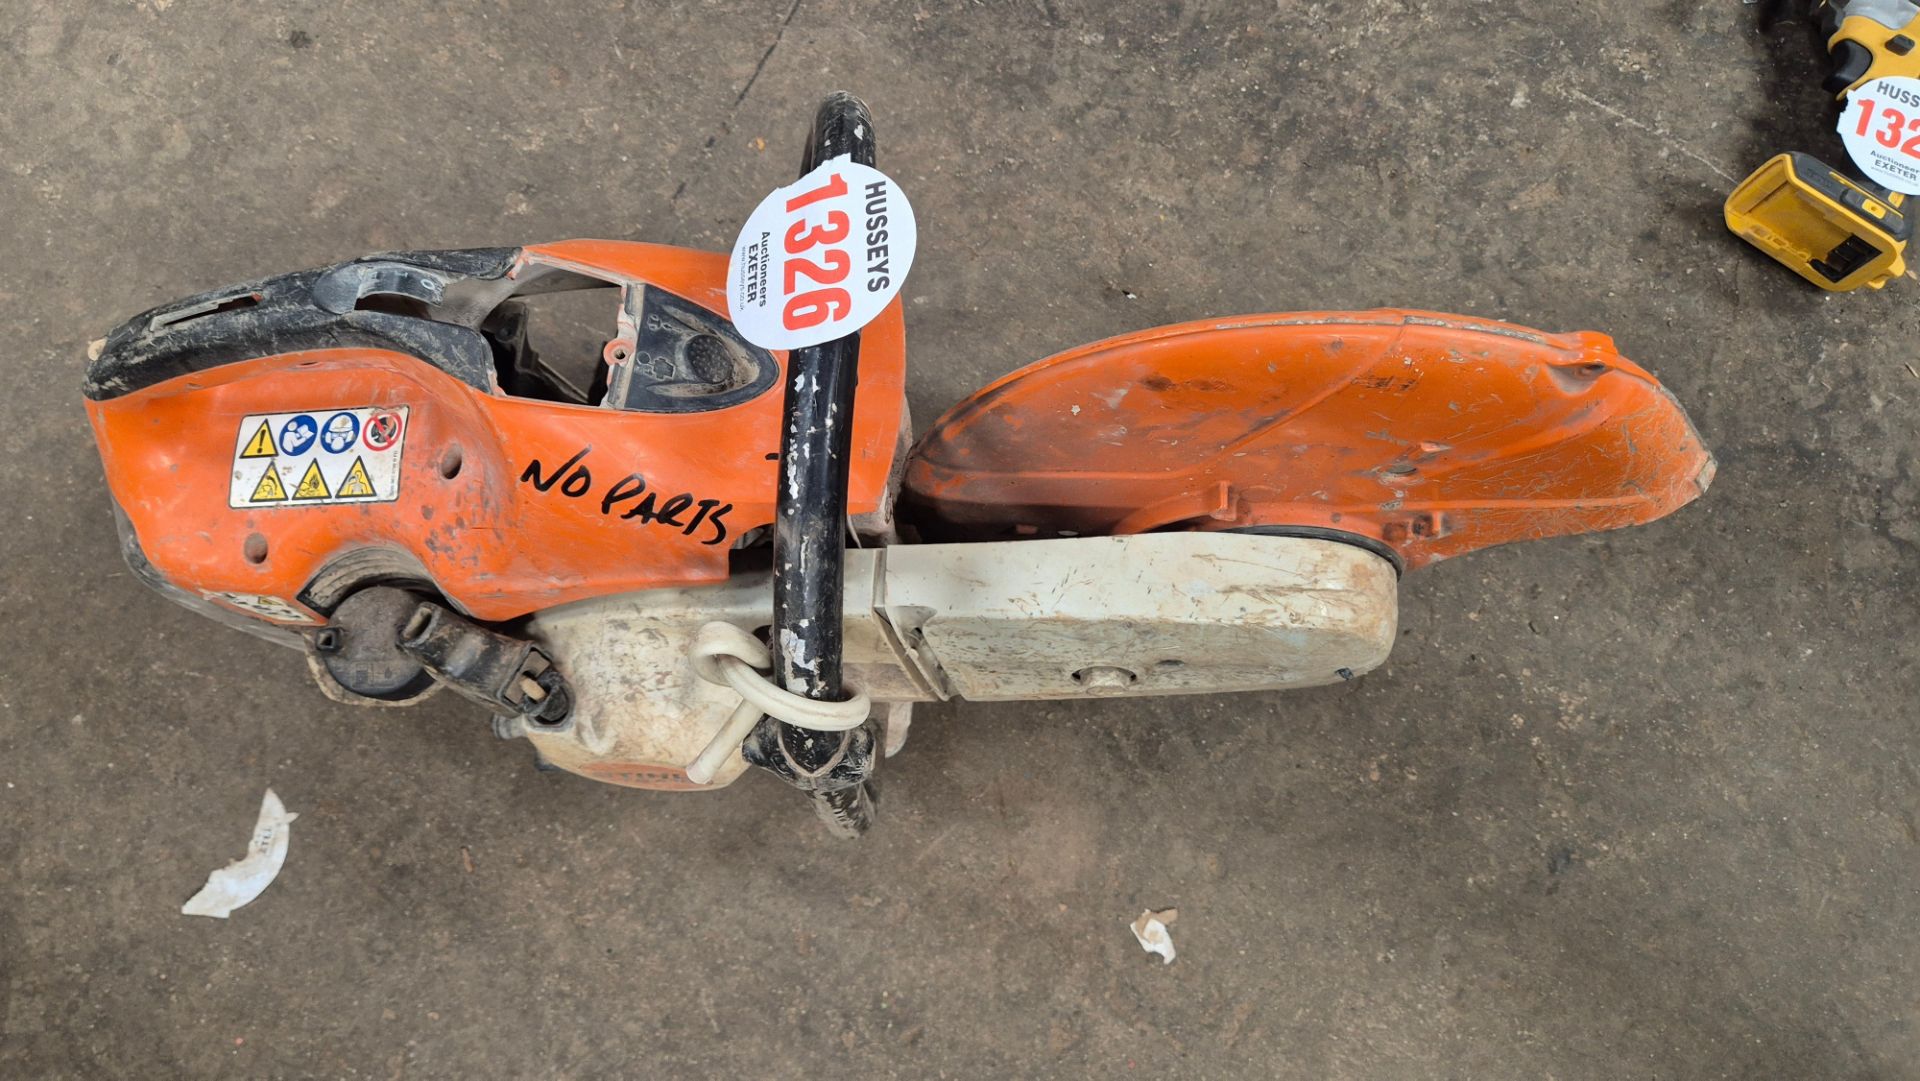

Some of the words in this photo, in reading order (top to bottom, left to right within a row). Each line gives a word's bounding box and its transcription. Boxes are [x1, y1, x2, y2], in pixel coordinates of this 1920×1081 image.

[1875, 159, 1917, 181] EXETER
[747, 243, 759, 303] EXETER
[759, 231, 770, 307] Auctioneers
[782, 173, 851, 331] 1326
[865, 180, 890, 292] HUSSEYS
[520, 444, 592, 498] NO
[601, 473, 733, 545] PARTS
